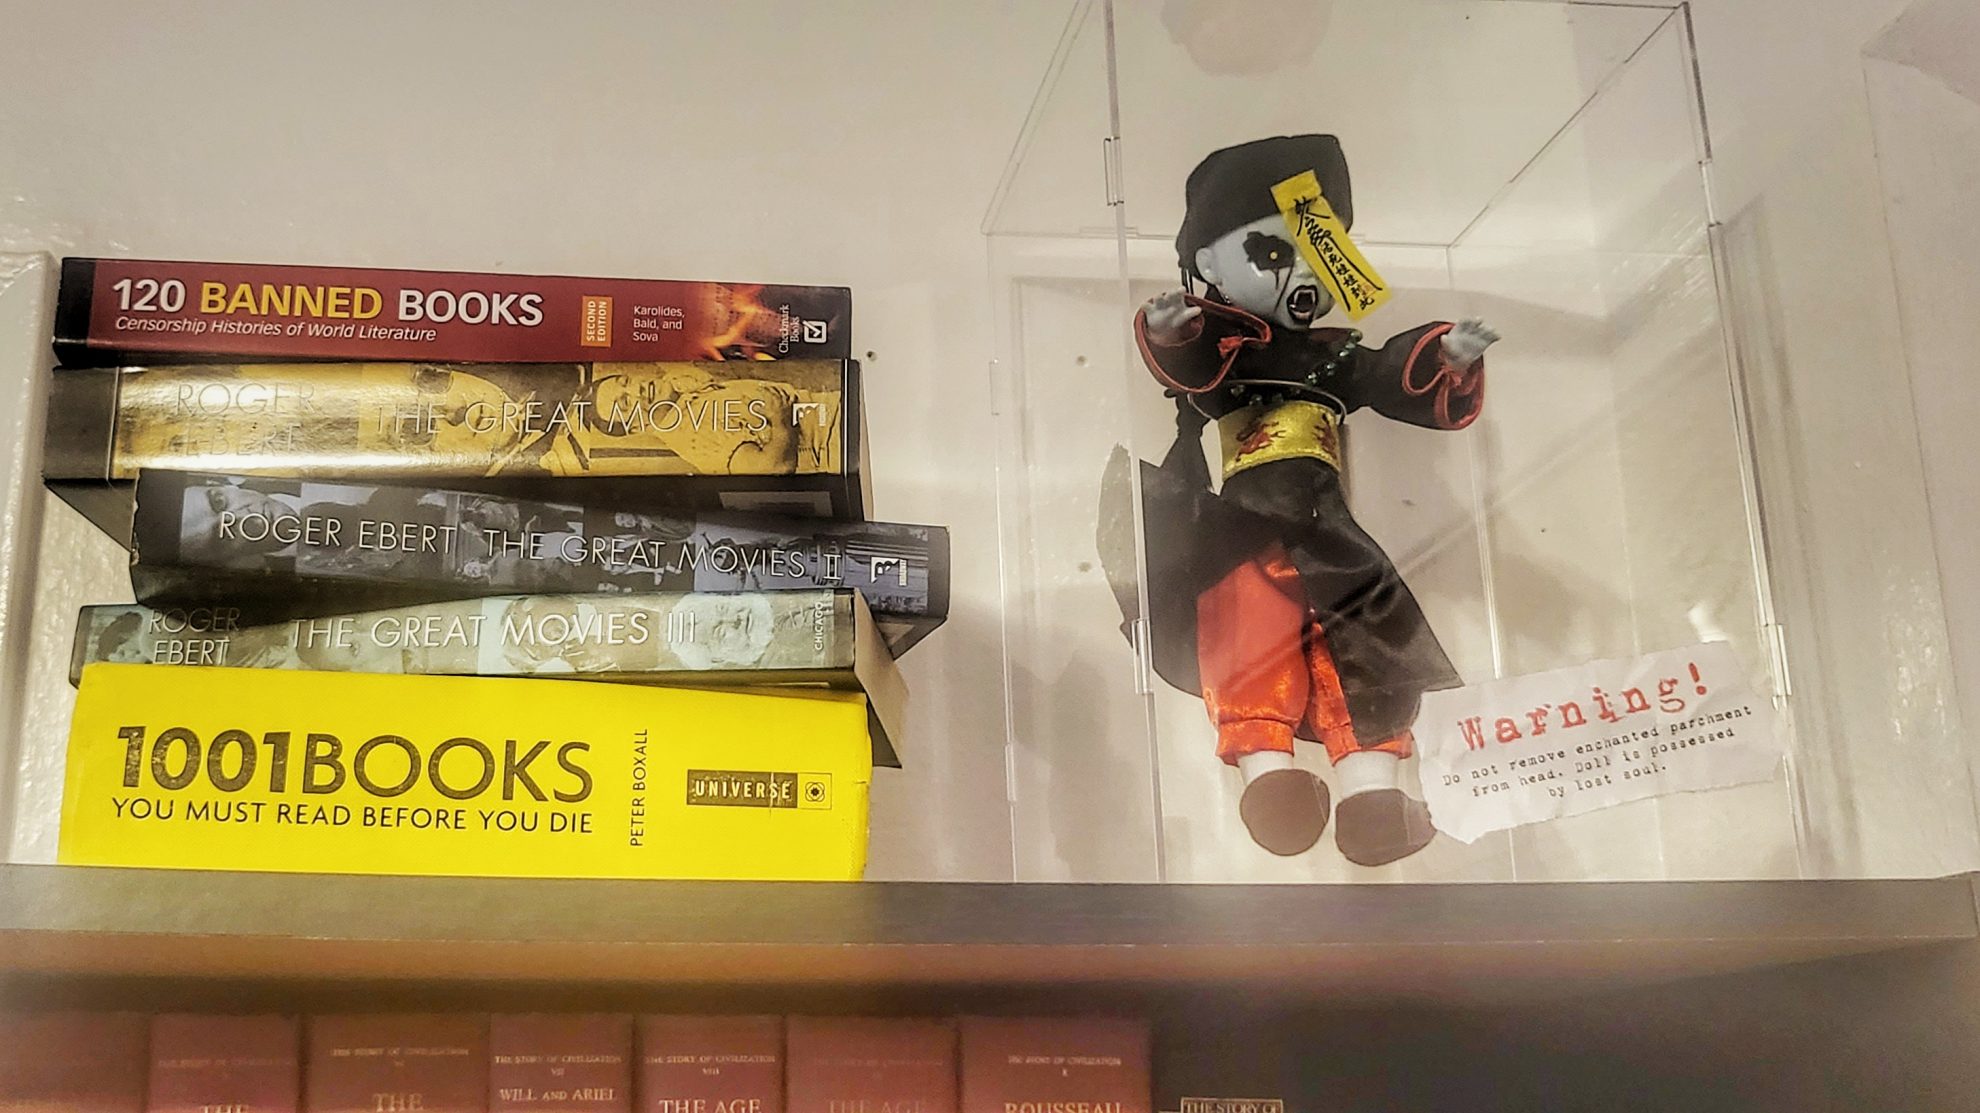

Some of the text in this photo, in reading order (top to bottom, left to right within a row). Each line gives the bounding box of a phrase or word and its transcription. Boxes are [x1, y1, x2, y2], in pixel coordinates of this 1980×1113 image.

[113, 279, 544, 327] 120 BANNED BOOKS
[633, 305, 685, 318] Karolides,
[115, 316, 437, 341] Censorship Histories of World Literature
[586, 300, 597, 342] SECOND
[597, 301, 607, 342] EDITION
[632, 331, 659, 342] Sova
[633, 319, 683, 330] Bald, and
[778, 304, 790, 353] Checkmark
[790, 316, 800, 342] Books
[174, 382, 315, 416] ROGER
[373, 400, 768, 434] THE GREAT MOVIES
[183, 422, 301, 455] EBERT
[219, 511, 843, 580] ROGER EBERT THE GREAT MOVIES II
[149, 606, 241, 635] ROGER
[291, 611, 695, 649] THE GREAT MOVIES III
[814, 601, 825, 651] CHICAGO
[153, 638, 231, 665] EBERT
[1457, 662, 1707, 751] Warning!
[1443, 706, 1752, 786] Do not remove enchanted parchment
[1472, 728, 1736, 797] from head. Doll is possessed
[630, 729, 648, 847] PETER BOXALL
[695, 780, 792, 800] UNIVERSE
[1547, 762, 1667, 798] by lost soul.
[112, 797, 593, 833] YOU MUST READ BEFORE YOU DIE
[372, 1092, 424, 1112] THE
[499, 1088, 616, 1101] WILL AND ARIEL
[659, 1098, 763, 1113] THE AGE
